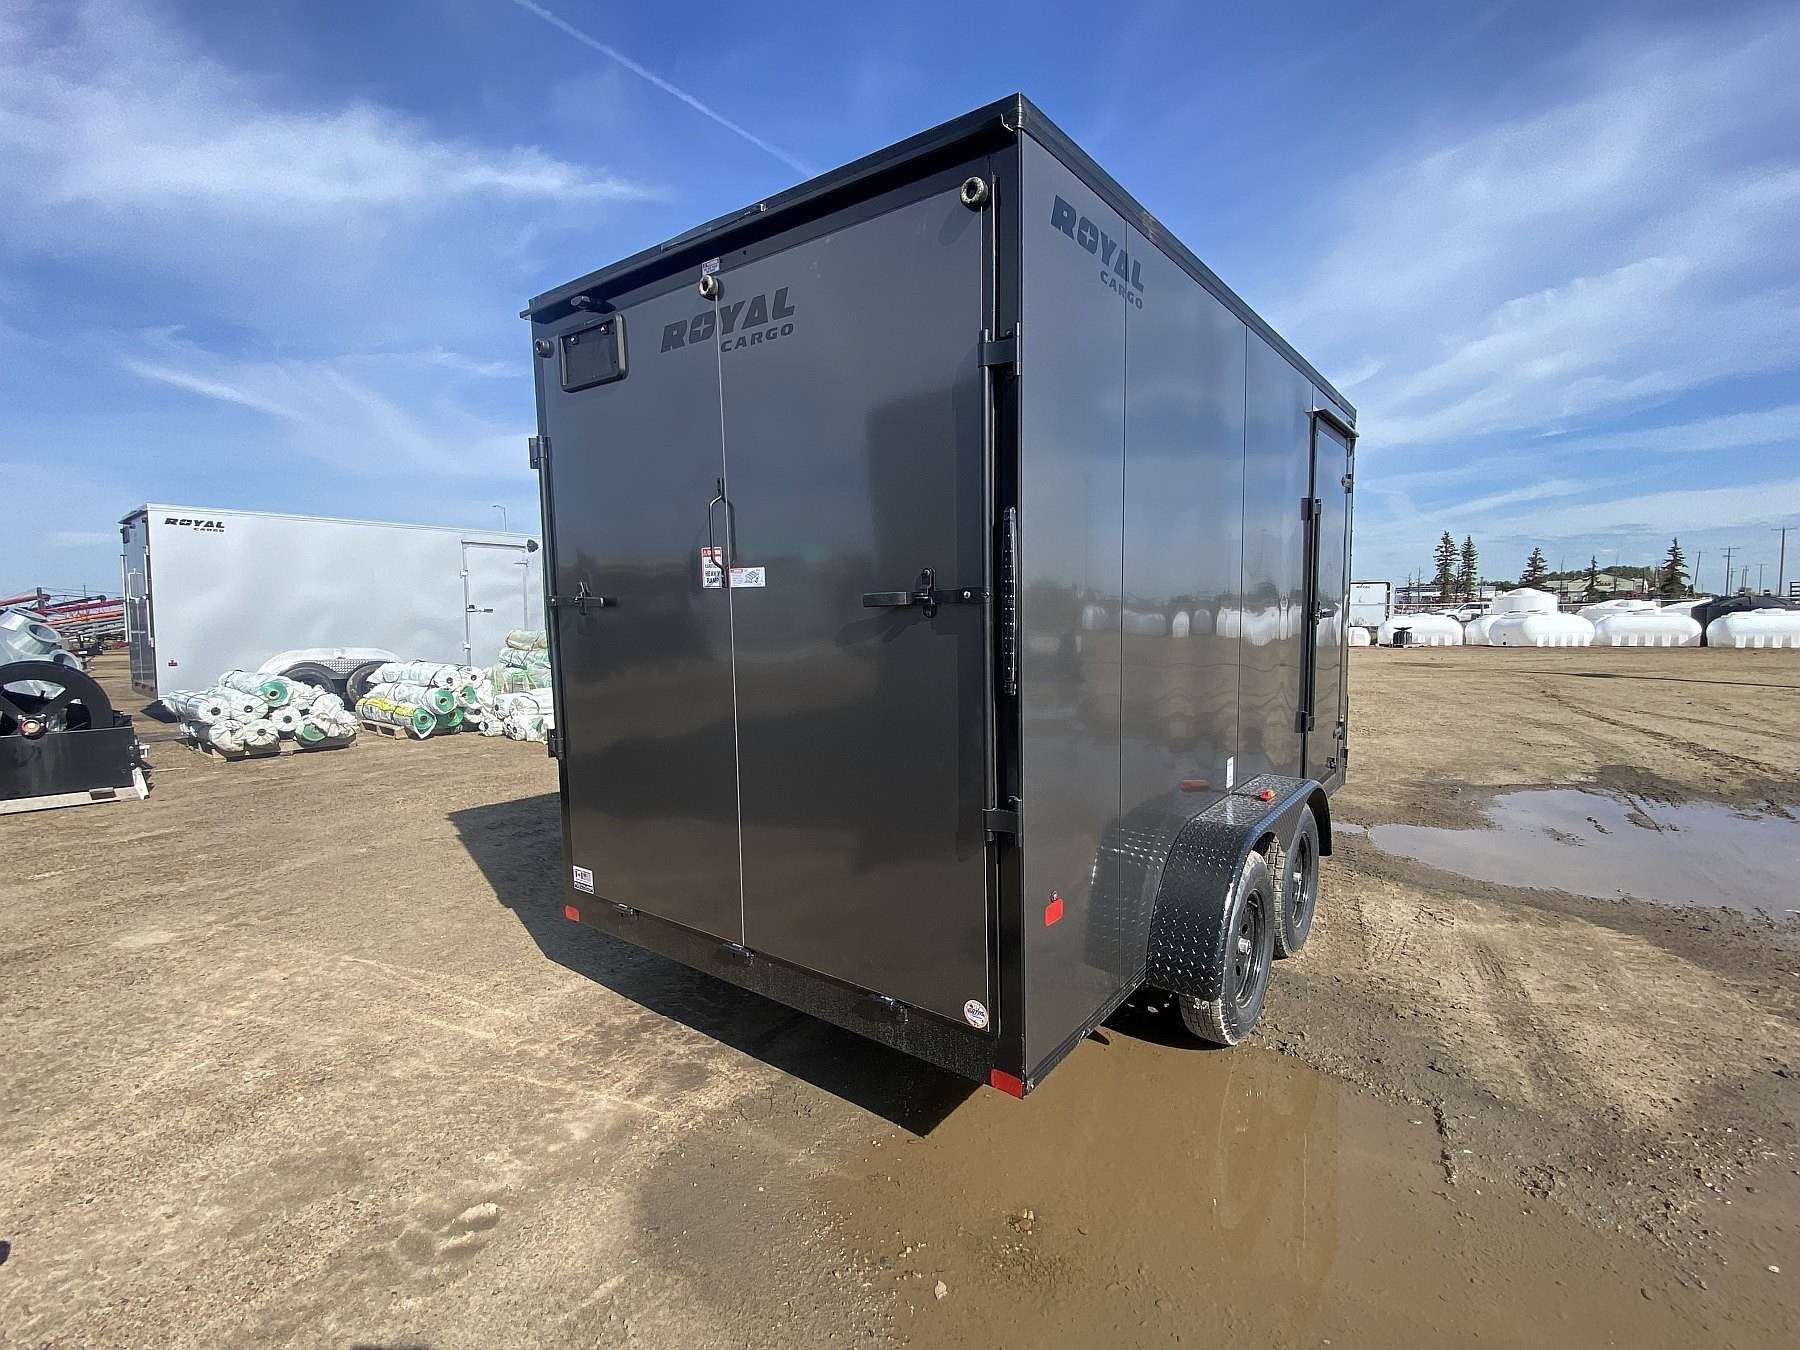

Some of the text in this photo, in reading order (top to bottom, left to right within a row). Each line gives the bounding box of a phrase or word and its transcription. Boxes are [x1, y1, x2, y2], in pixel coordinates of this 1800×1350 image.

[1051, 195, 1144, 293] ROYAL
[1100, 270, 1143, 310] CARGO
[660, 286, 795, 353] ROYAL
[720, 323, 794, 353] CARGO
[164, 518, 225, 529] ROYAL
